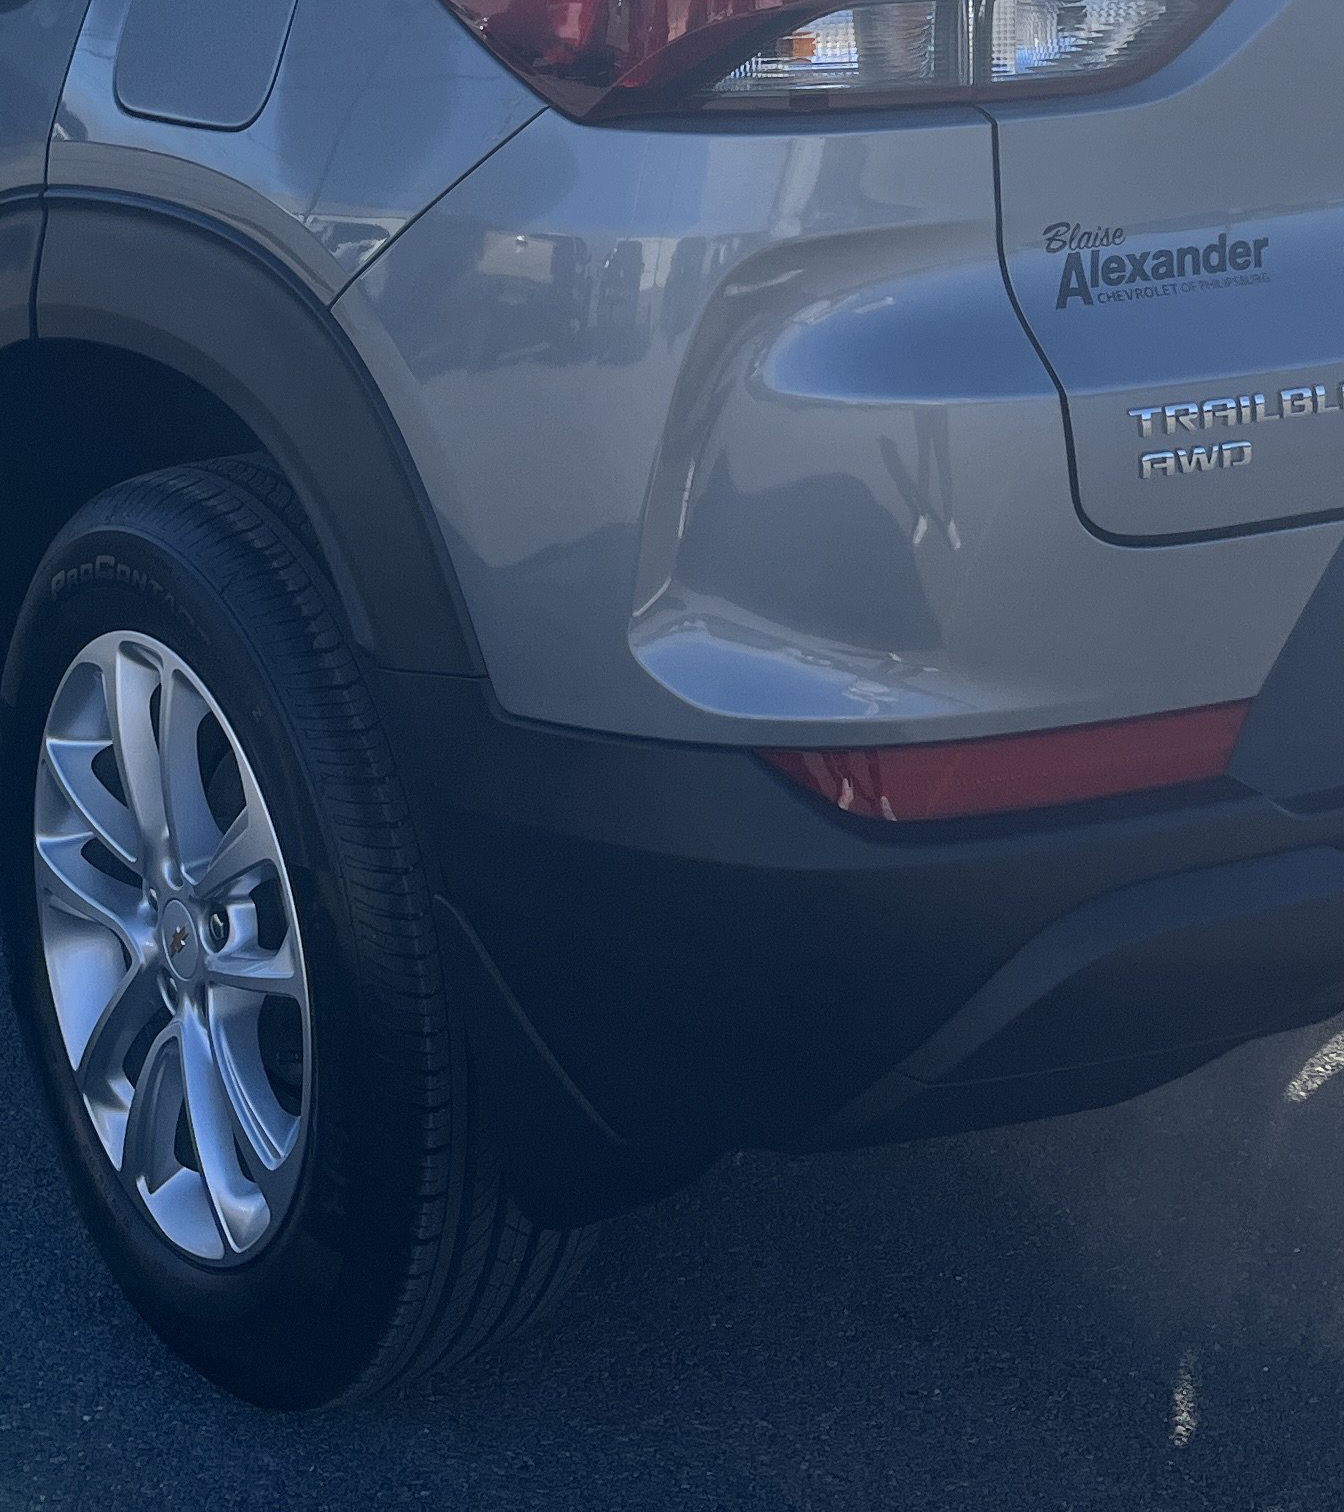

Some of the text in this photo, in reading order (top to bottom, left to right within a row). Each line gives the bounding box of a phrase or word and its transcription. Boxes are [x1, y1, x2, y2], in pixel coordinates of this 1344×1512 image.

[1043, 221, 1126, 254] Blaise
[1055, 233, 1269, 309] Alexander
[1097, 283, 1178, 305] CHEVROLET
[1180, 280, 1198, 294] OF
[1137, 439, 1253, 480] AWD
